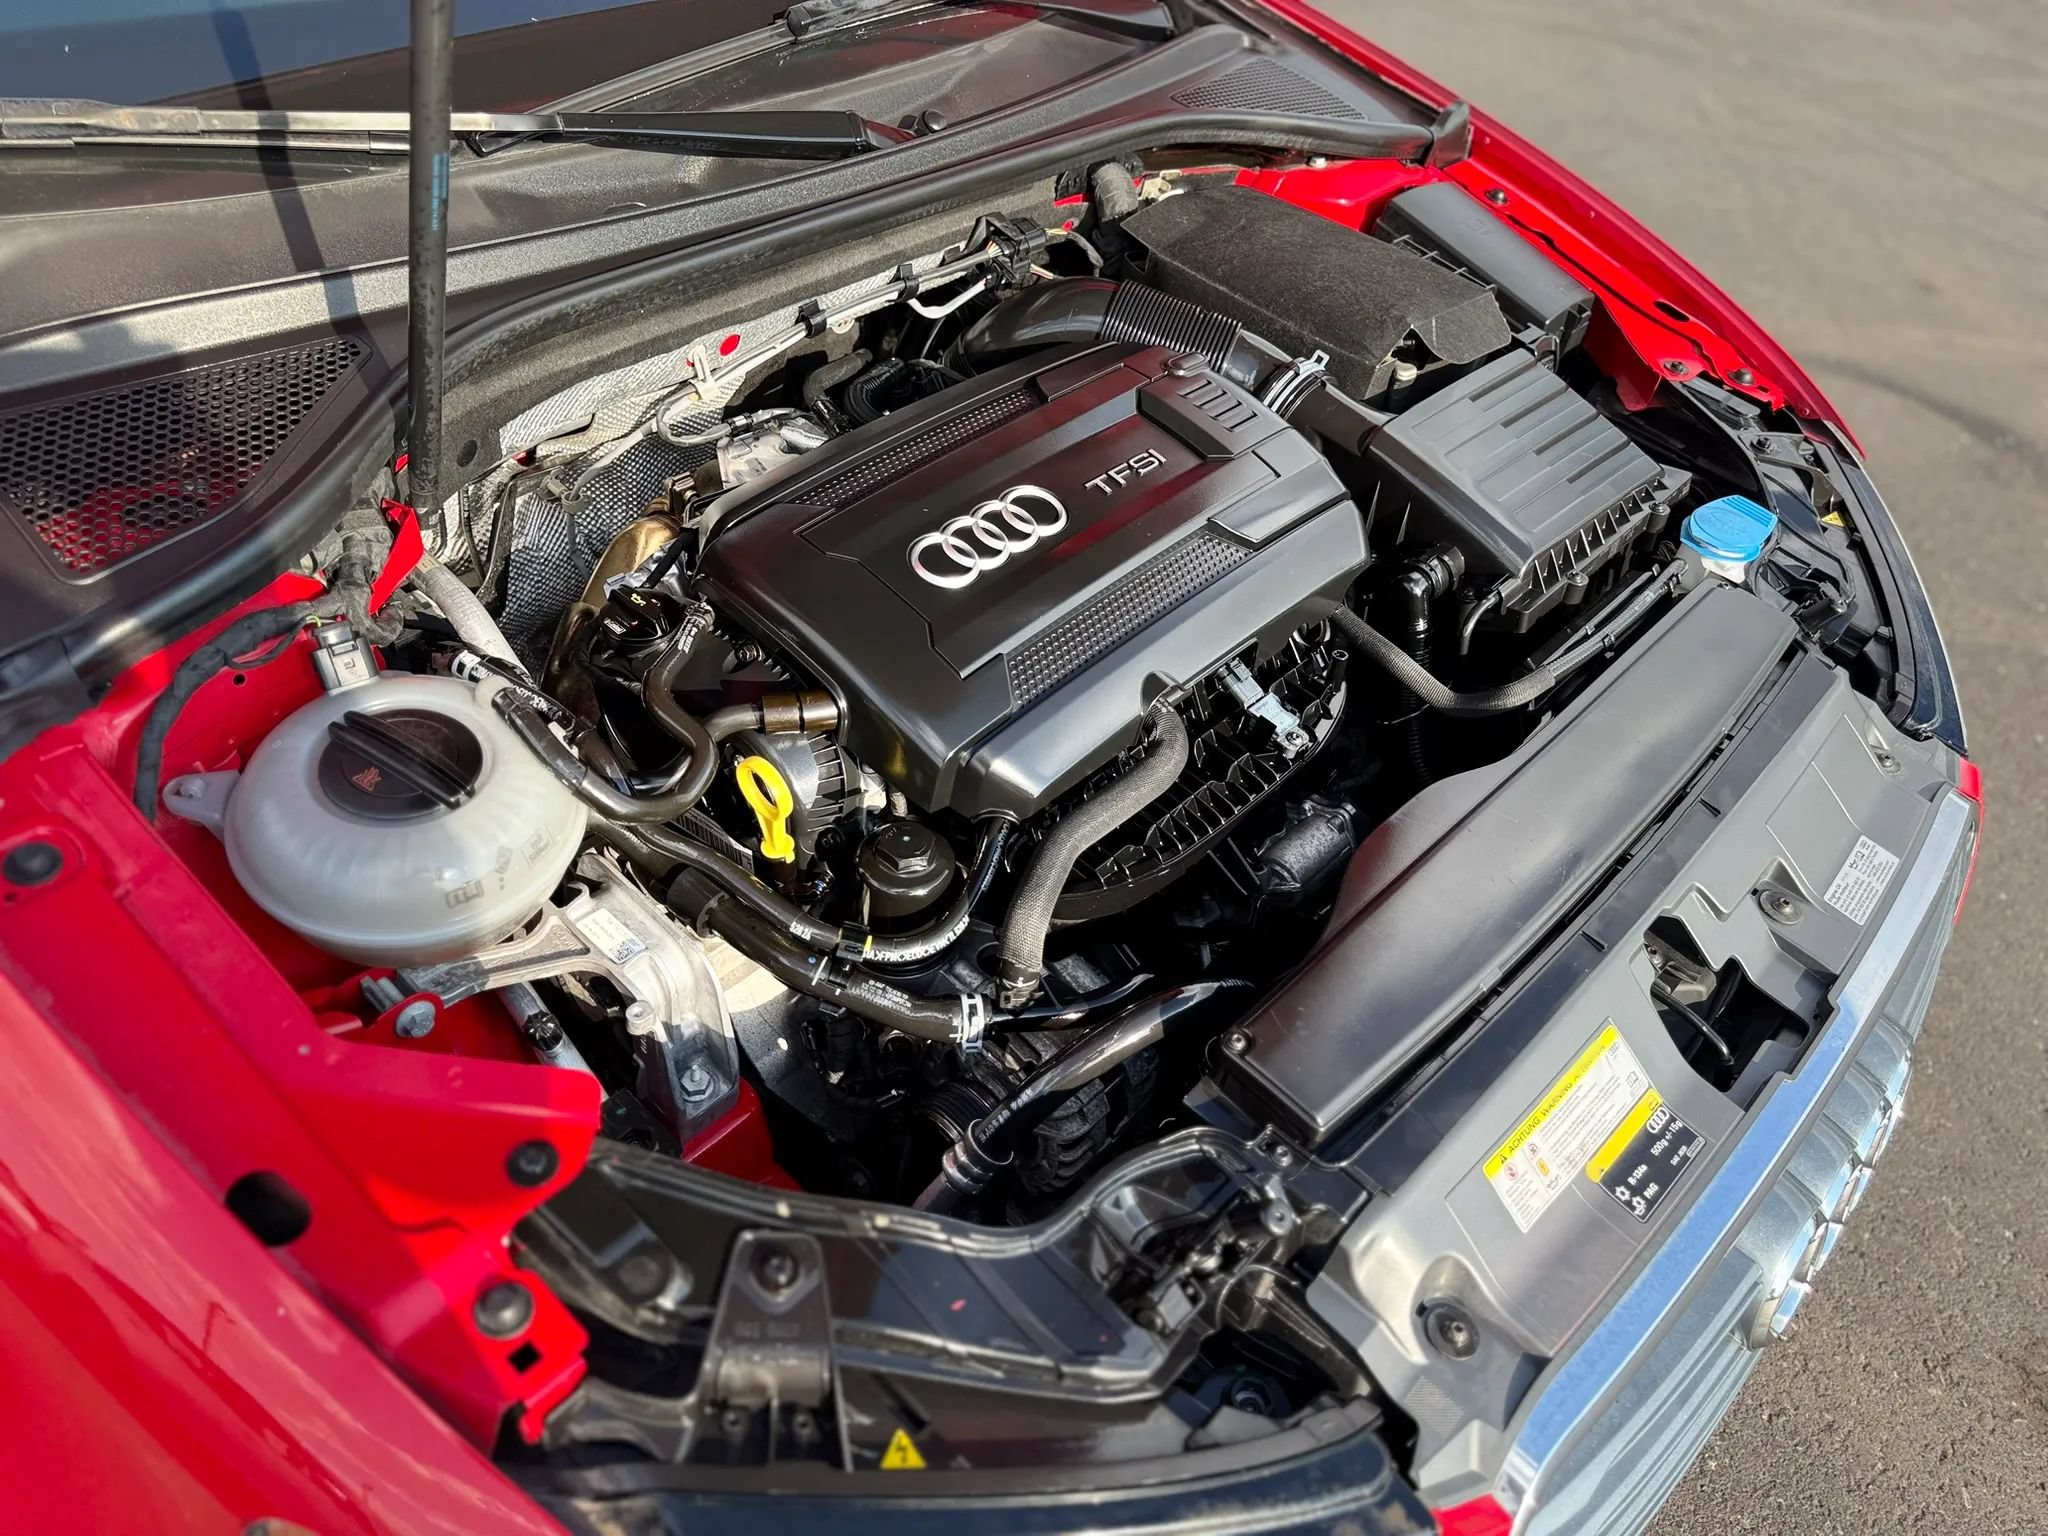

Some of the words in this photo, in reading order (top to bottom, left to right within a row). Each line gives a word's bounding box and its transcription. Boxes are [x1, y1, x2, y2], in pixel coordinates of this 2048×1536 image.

[1083, 448, 1167, 495] TFSI
[1508, 1116, 1541, 1154] ACHTUNG
[1627, 1163, 1648, 1186] R-134a
[1643, 1182, 1658, 1198] PAG
